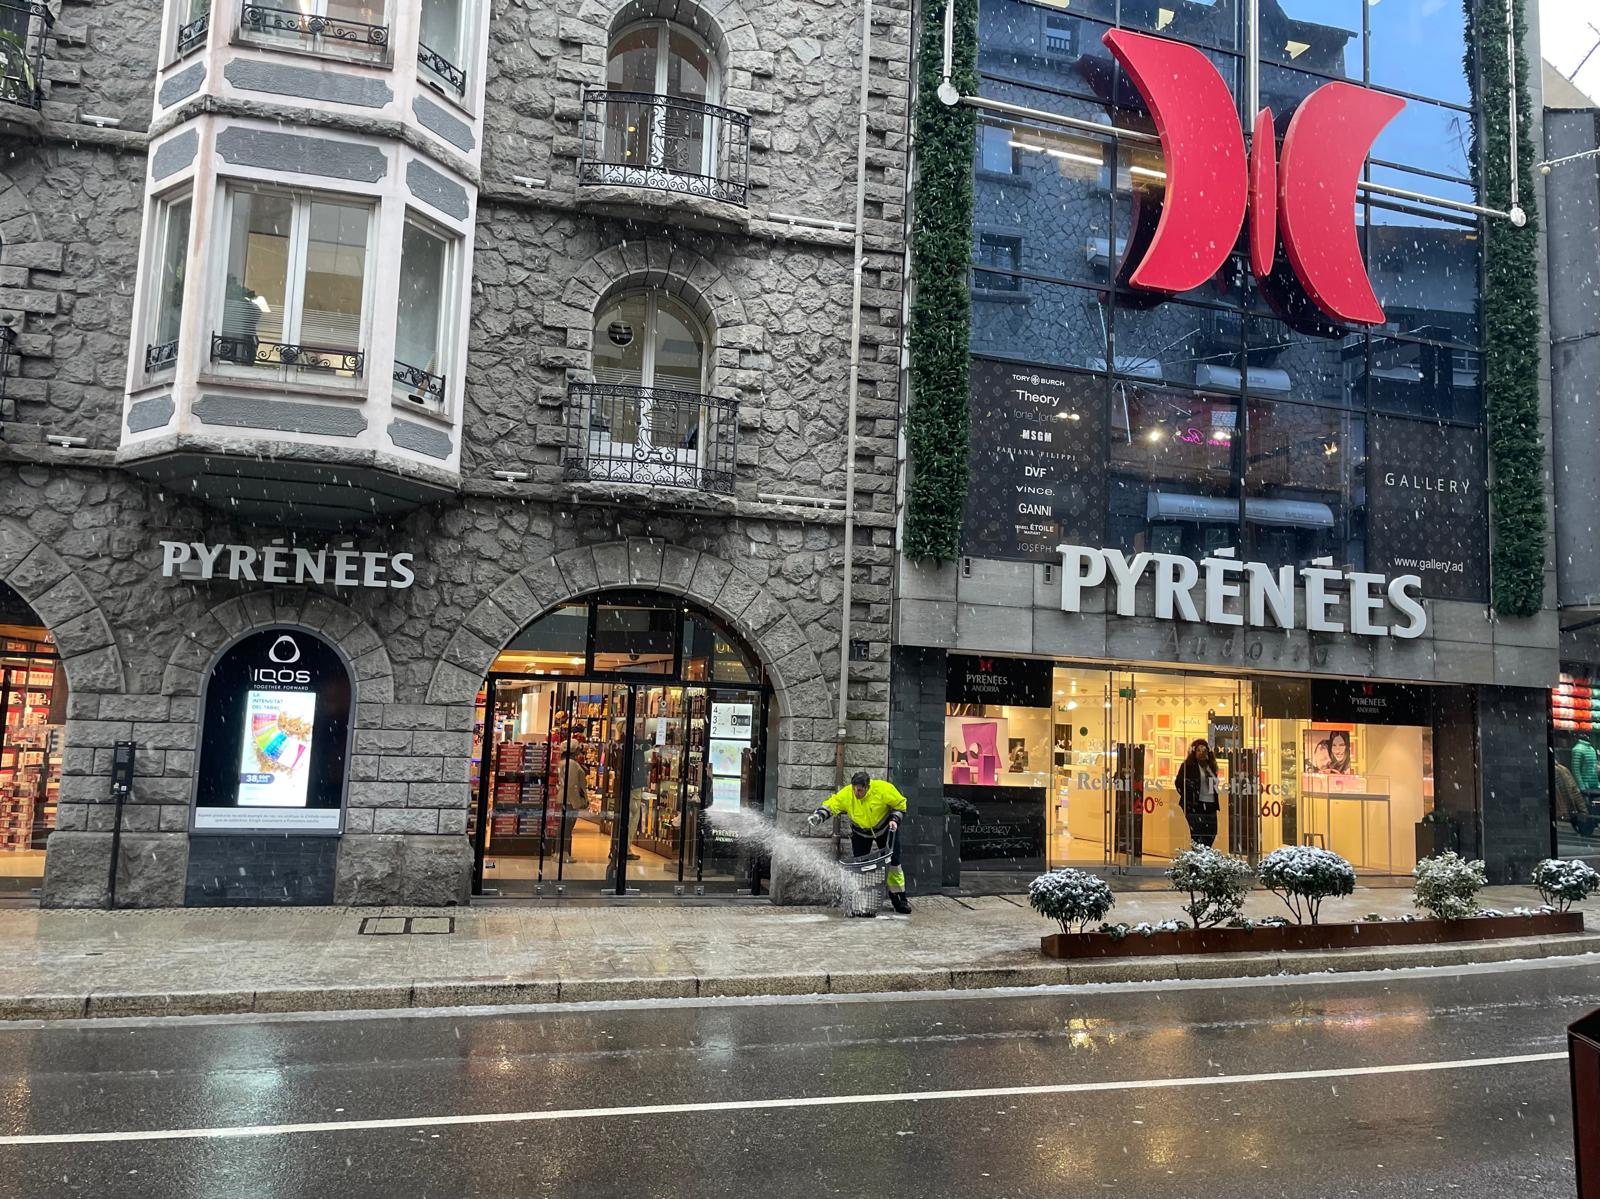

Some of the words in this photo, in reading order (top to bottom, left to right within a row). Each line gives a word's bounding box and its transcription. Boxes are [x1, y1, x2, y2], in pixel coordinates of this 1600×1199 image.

[1012, 374, 1030, 382] TORY
[1041, 378, 1065, 387] BURCH
[1016, 389, 1059, 407] Theory
[1022, 429, 1052, 443] MSGM
[997, 446, 1034, 456] FABIANA
[1040, 451, 1075, 461] FILIPPI
[1025, 466, 1047, 477] DVF
[1385, 472, 1470, 495] GALLERY
[1018, 503, 1052, 516] GANNI
[1030, 523, 1054, 533] ÉTOILE
[159, 538, 415, 589] PYRÉNÉES
[1394, 557, 1464, 573] www.gallery.ad
[1056, 544, 1428, 639] PYRÉNÉES
[254, 668, 311, 684] IQOS
[972, 684, 1000, 693] ANDORRA
